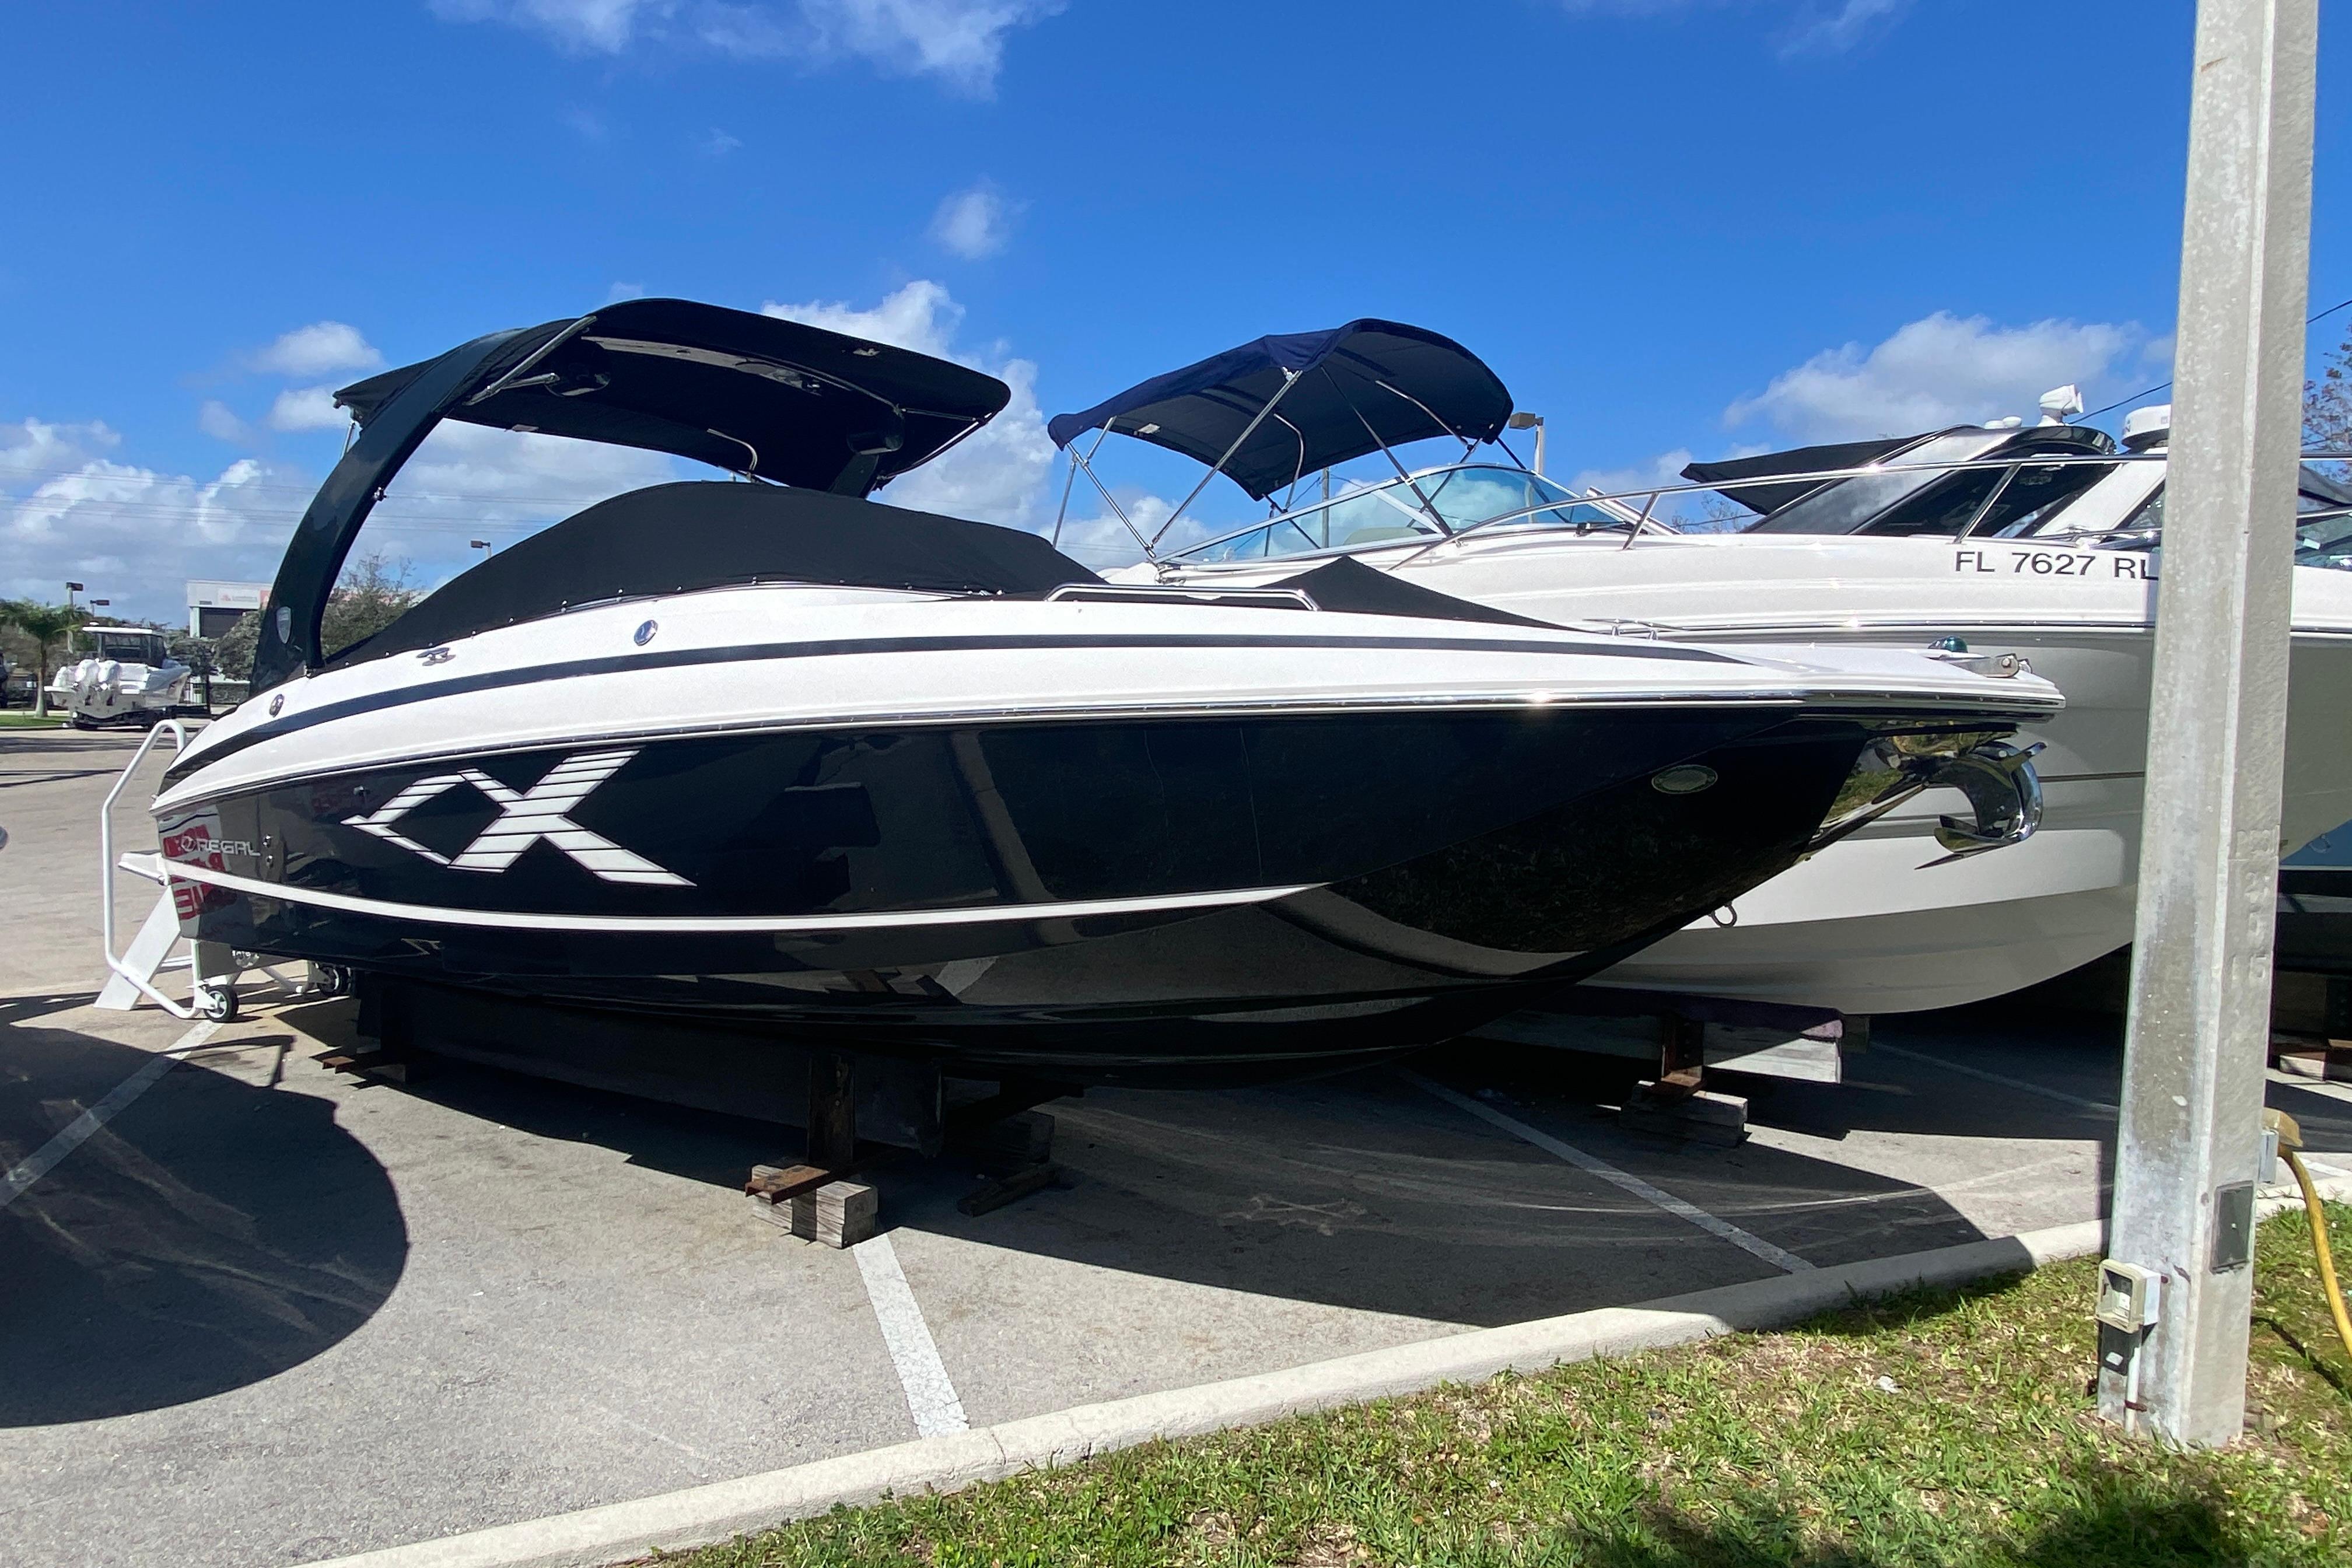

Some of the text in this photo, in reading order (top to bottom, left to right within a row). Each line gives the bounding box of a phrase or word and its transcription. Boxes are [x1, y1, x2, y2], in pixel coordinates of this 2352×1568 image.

[1955, 551, 2159, 580] FL 7627 RL
[196, 838, 261, 856] REGAL
